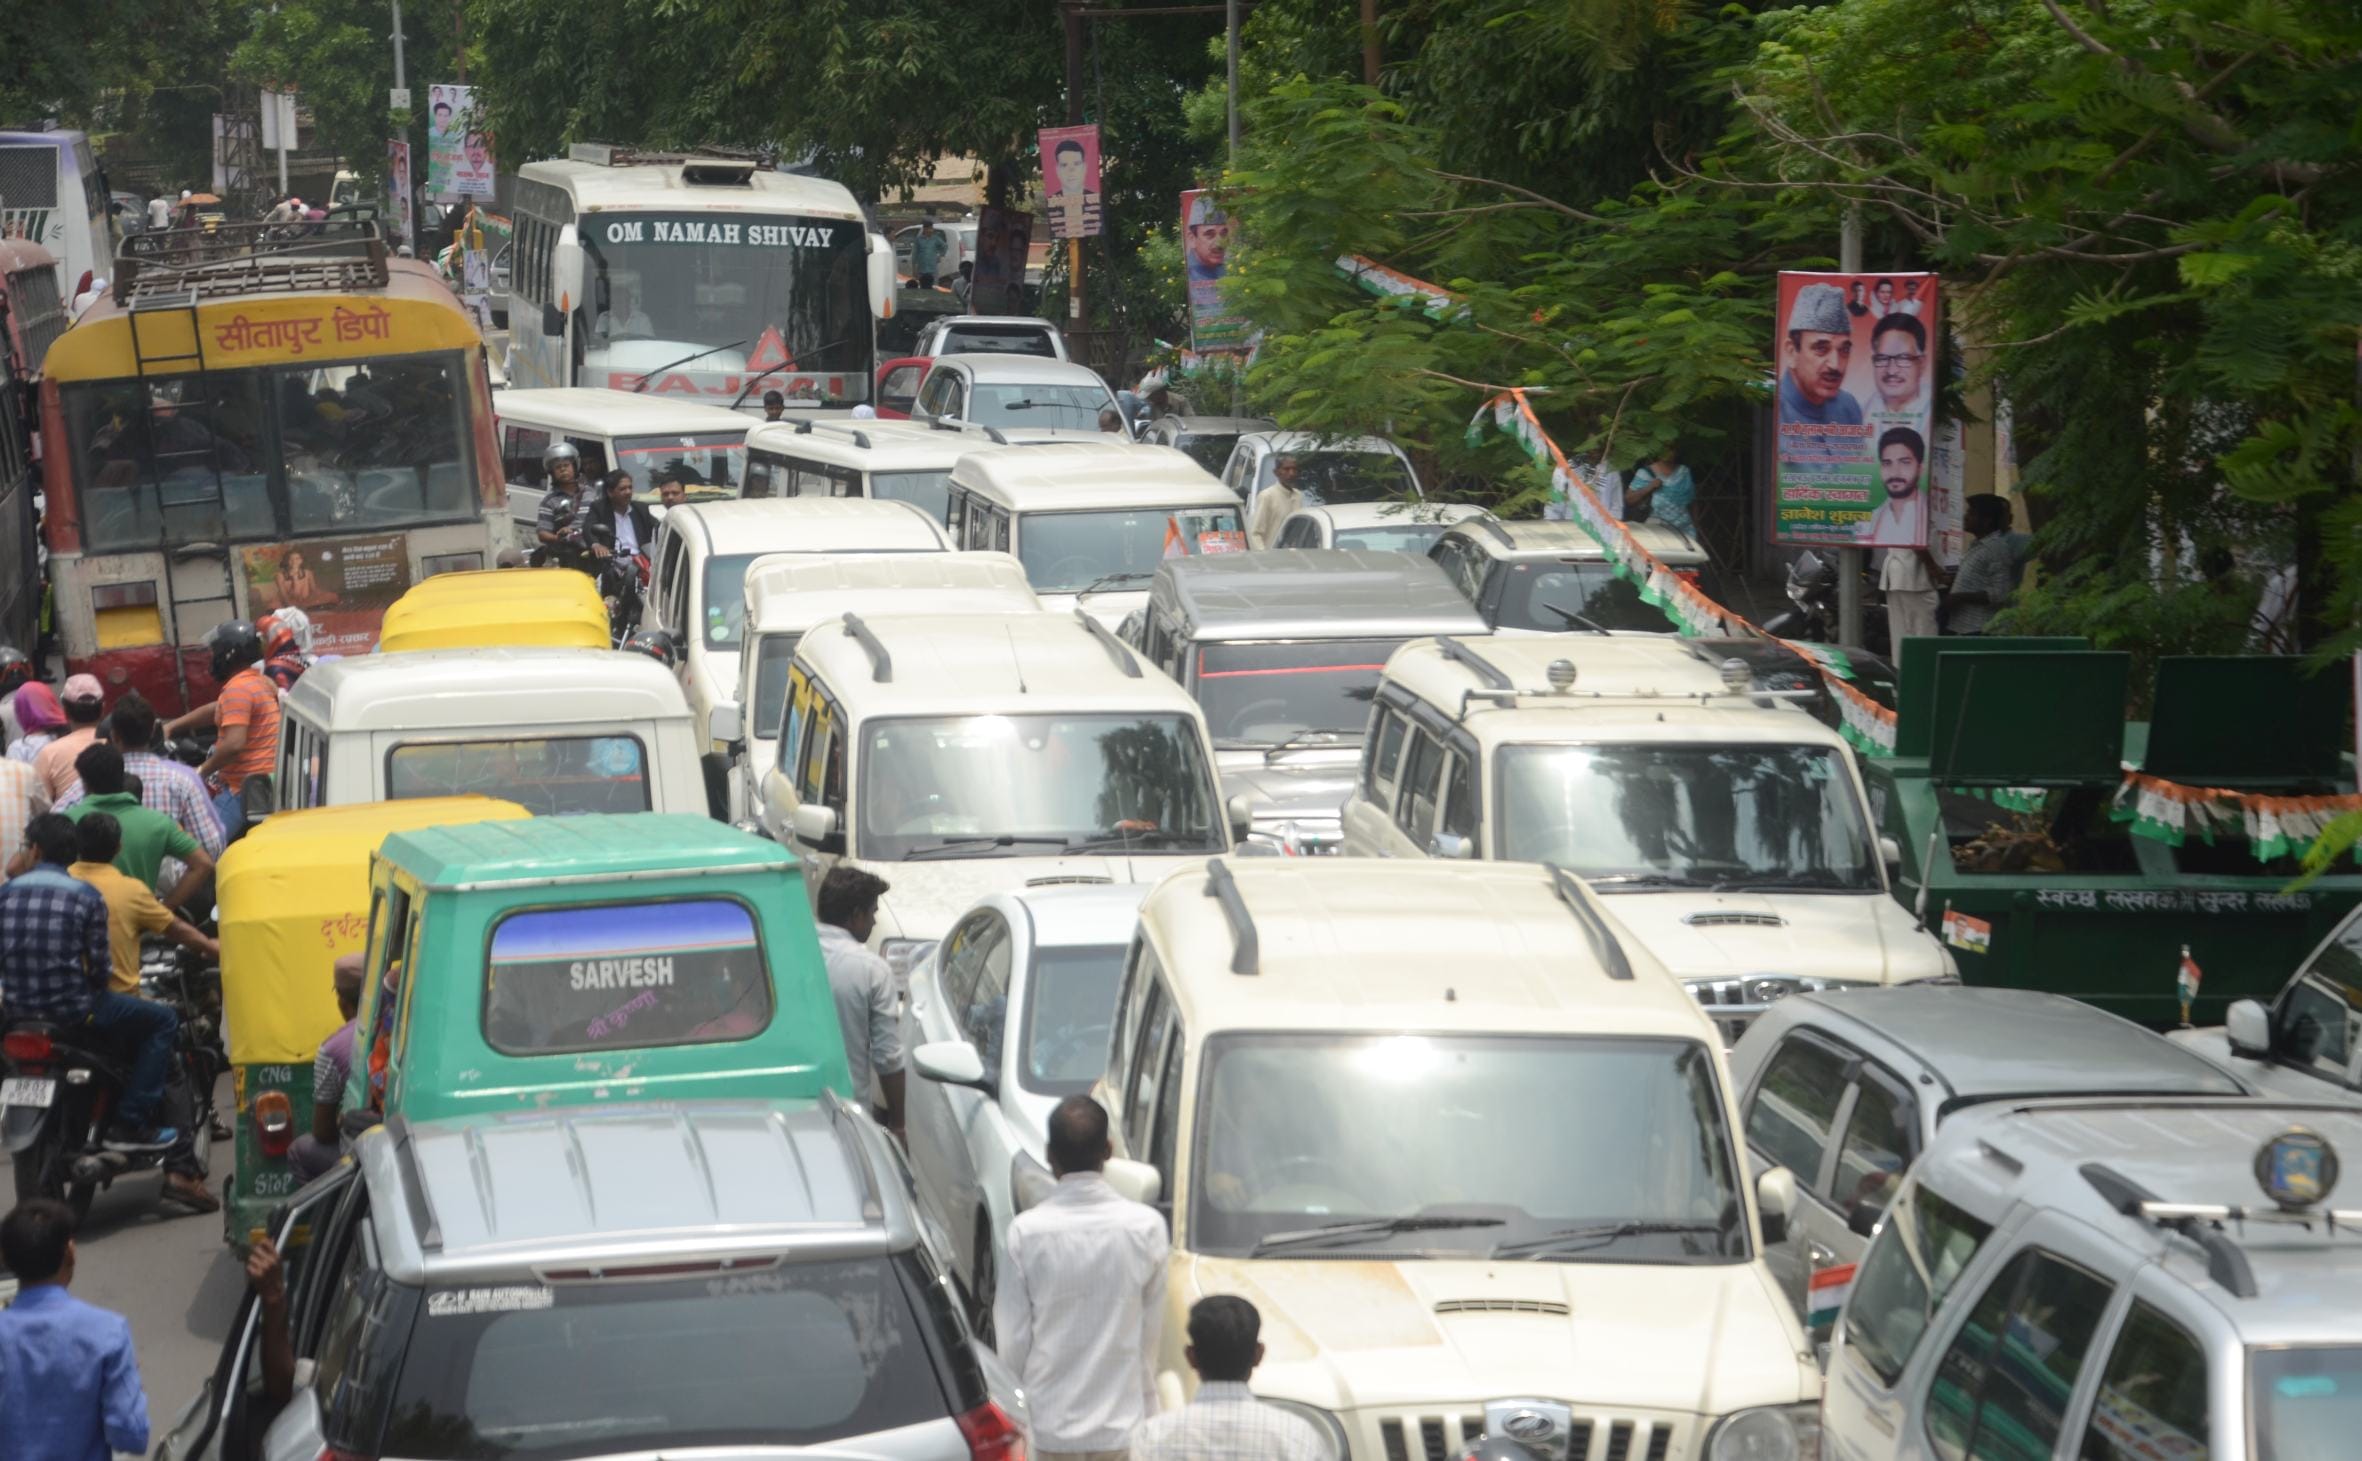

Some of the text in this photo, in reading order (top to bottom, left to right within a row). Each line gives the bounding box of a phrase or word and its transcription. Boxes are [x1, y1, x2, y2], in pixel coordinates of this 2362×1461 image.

[607, 221, 832, 247] OM NAMAH SHIVAY
[214, 305, 391, 354] सीतापुर डिपो
[608, 373, 842, 396] BAJPAI
[1783, 485, 1870, 503] हार्दिक स्वागत
[570, 957, 674, 990] SARVESH
[259, 1066, 293, 1084] CNG
